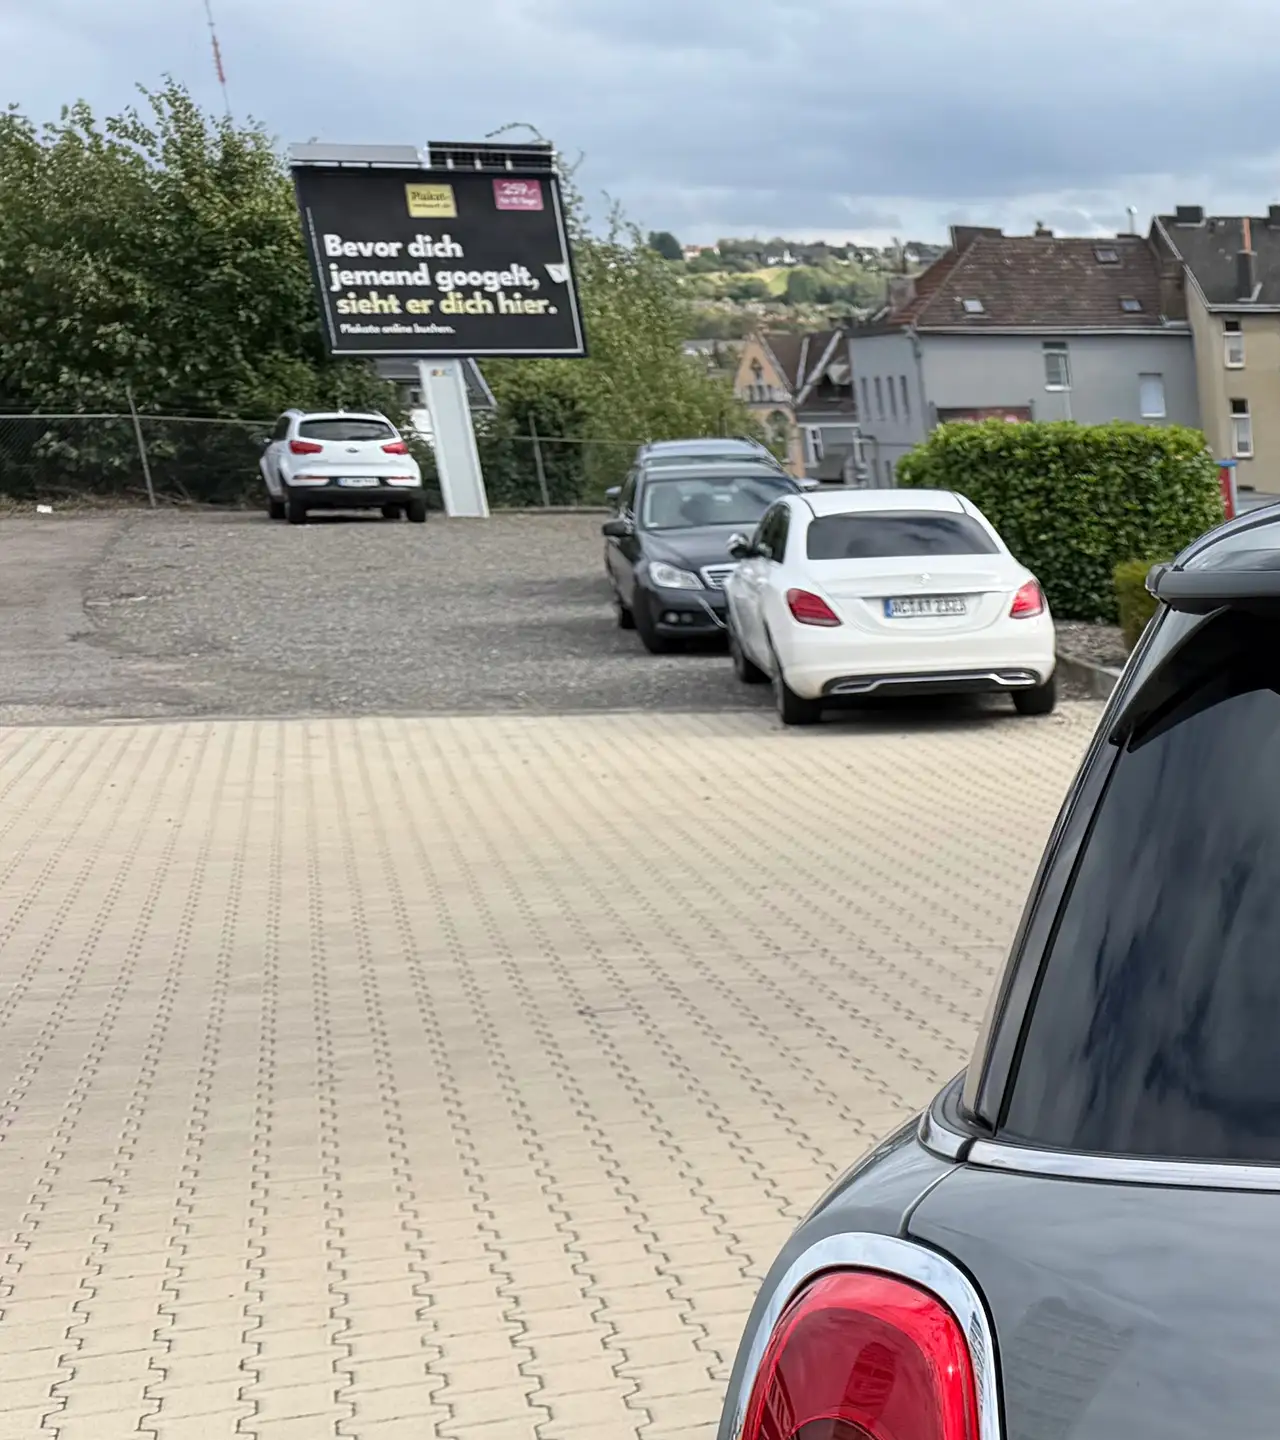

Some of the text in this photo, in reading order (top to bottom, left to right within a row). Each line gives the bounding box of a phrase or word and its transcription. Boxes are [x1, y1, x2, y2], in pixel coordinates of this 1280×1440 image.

[323, 234, 464, 258] Bevor dich
[329, 262, 540, 292] jemand googelt,
[336, 291, 558, 315] sieht er dich hier.
